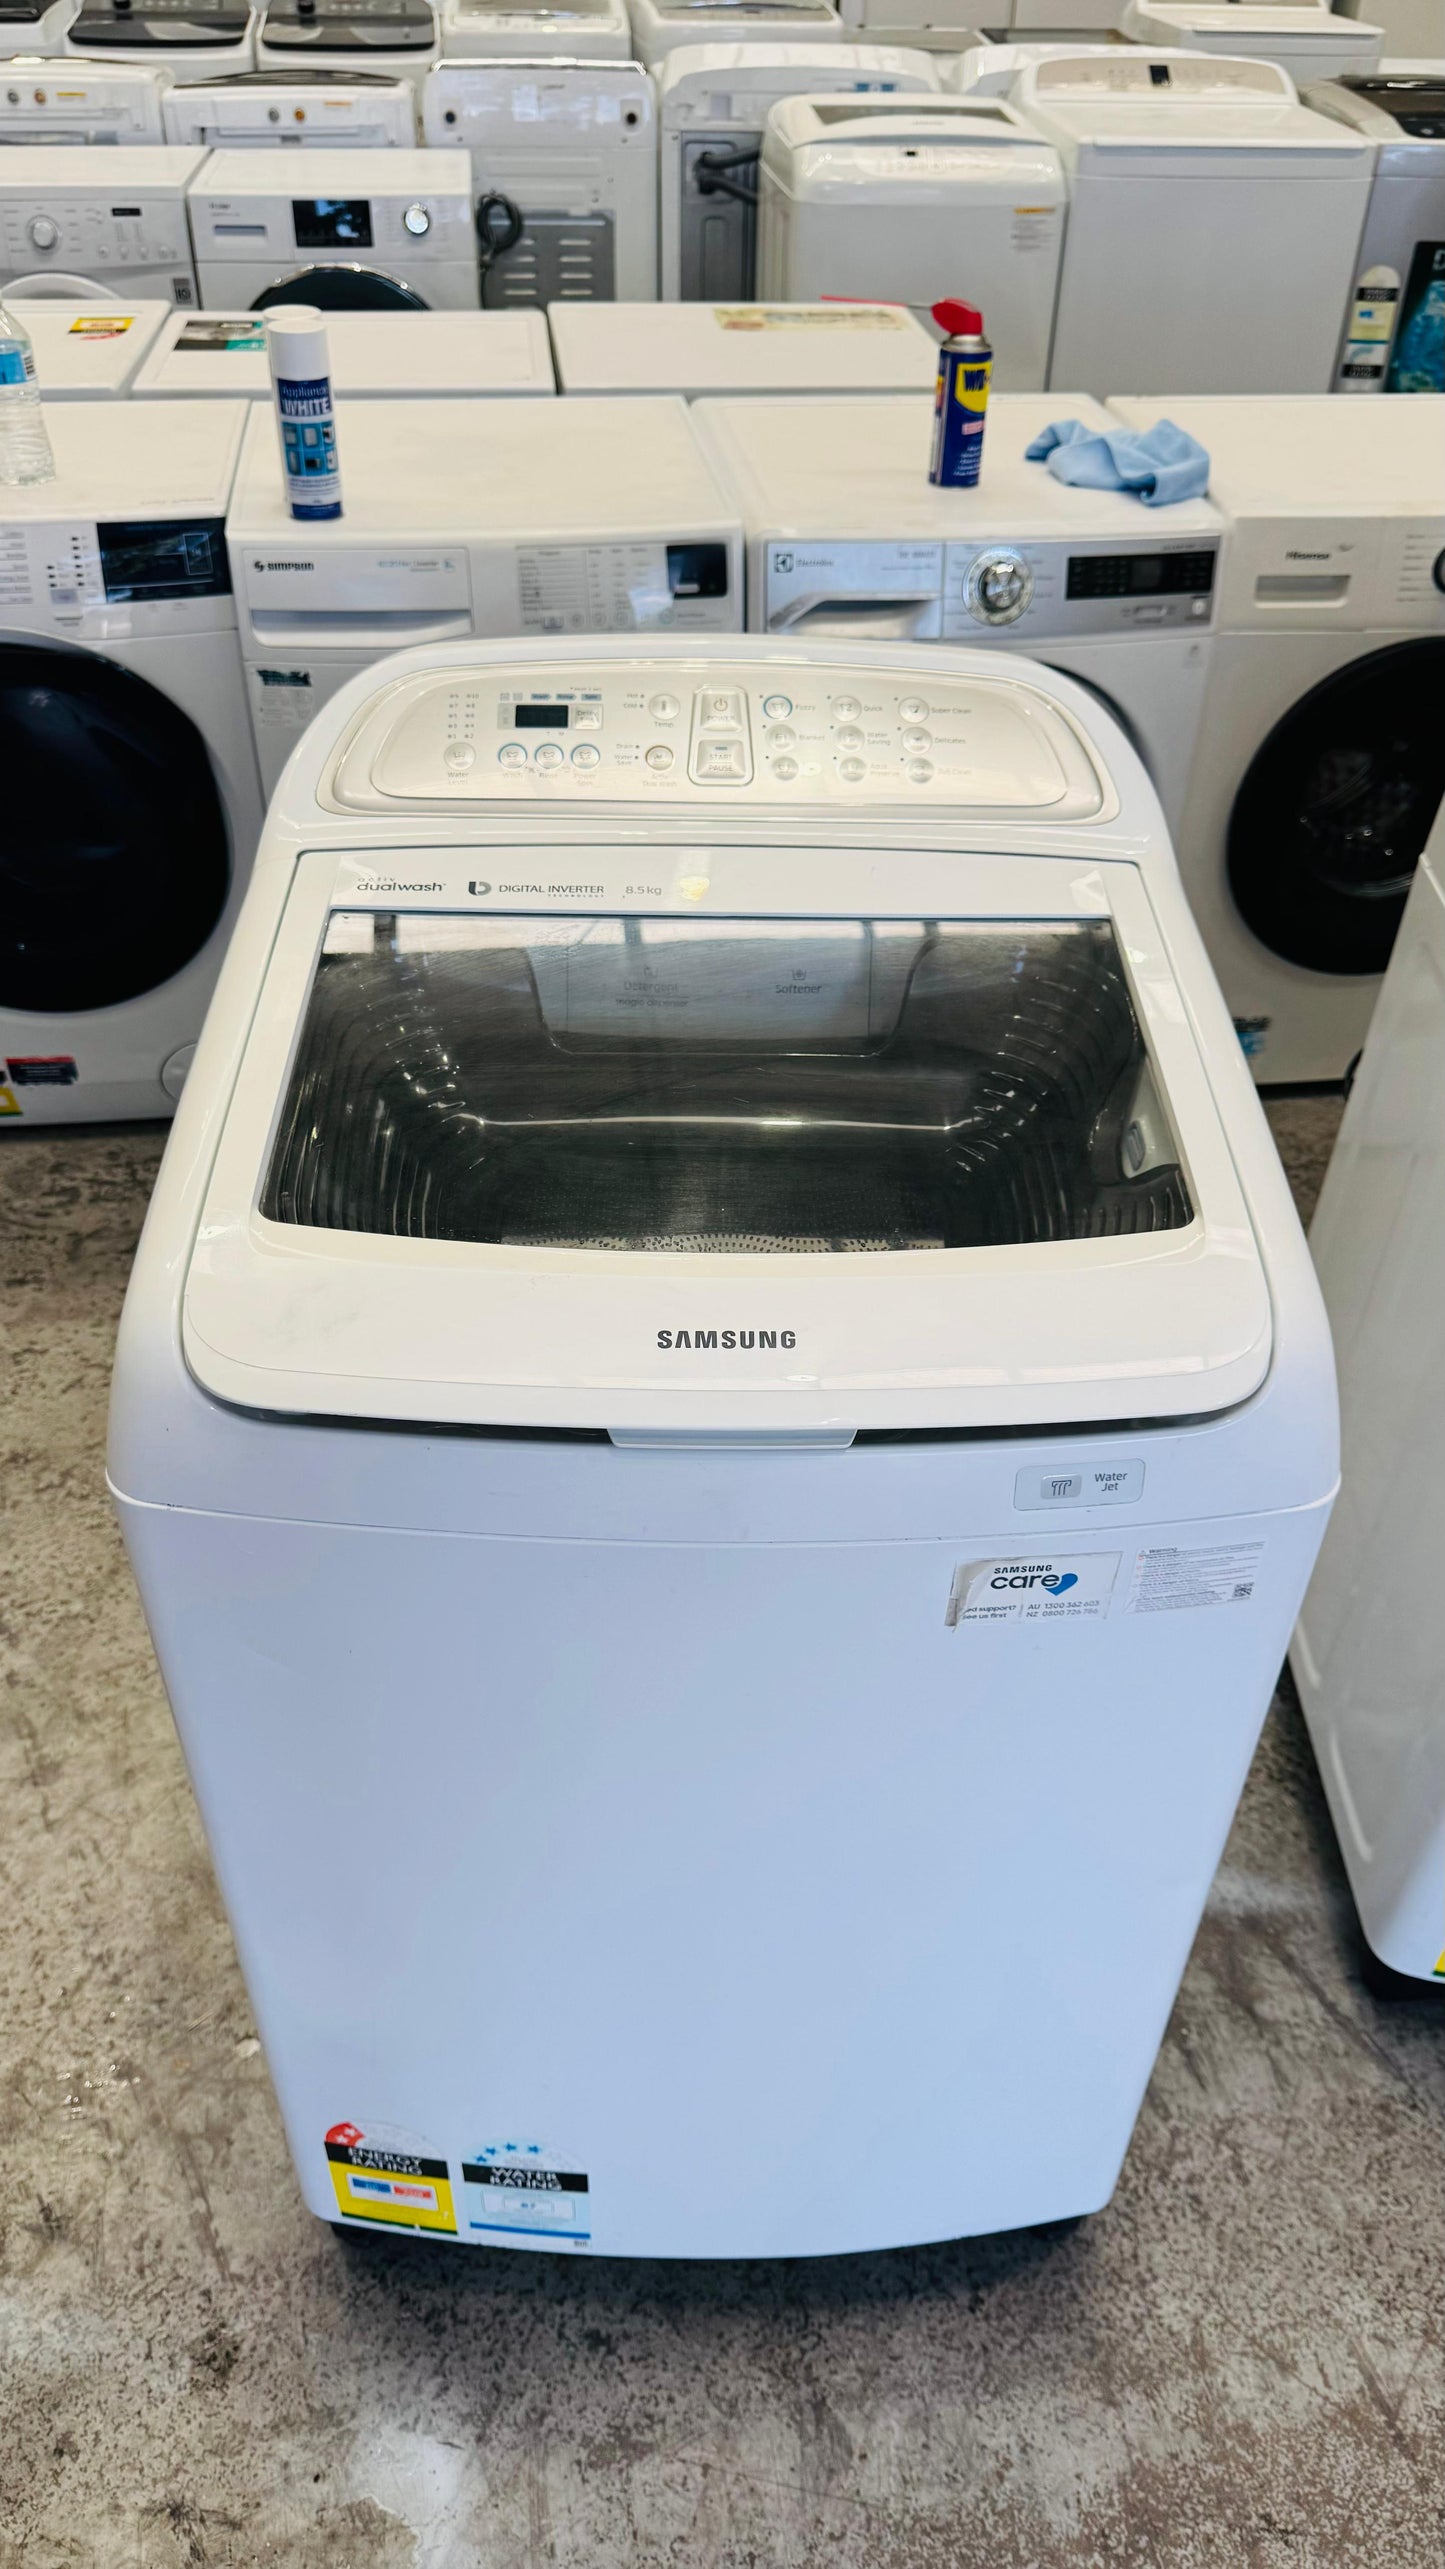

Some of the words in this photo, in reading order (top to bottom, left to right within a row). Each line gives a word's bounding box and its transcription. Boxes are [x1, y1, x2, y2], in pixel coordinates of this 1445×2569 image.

[283, 397, 330, 417] WHITE
[356, 882, 443, 892] dualwash
[499, 884, 545, 893] DIGITAL
[548, 885, 605, 894] INVERTER
[775, 984, 823, 994] Softener
[657, 1330, 796, 1349] SAMSUNG
[1094, 1472, 1128, 1482] Water
[1101, 1482, 1119, 1492] Jet
[994, 1564, 1053, 1574] SAMSUNG
[990, 1574, 1060, 1590] care
[979, 1604, 1017, 1613] support?
[1044, 1602, 1065, 1610] 1300
[348, 2147, 423, 2166] ENERGY
[351, 2156, 423, 2176] RATING
[492, 2166, 557, 2180] WATER
[490, 2174, 562, 2192] RATING
